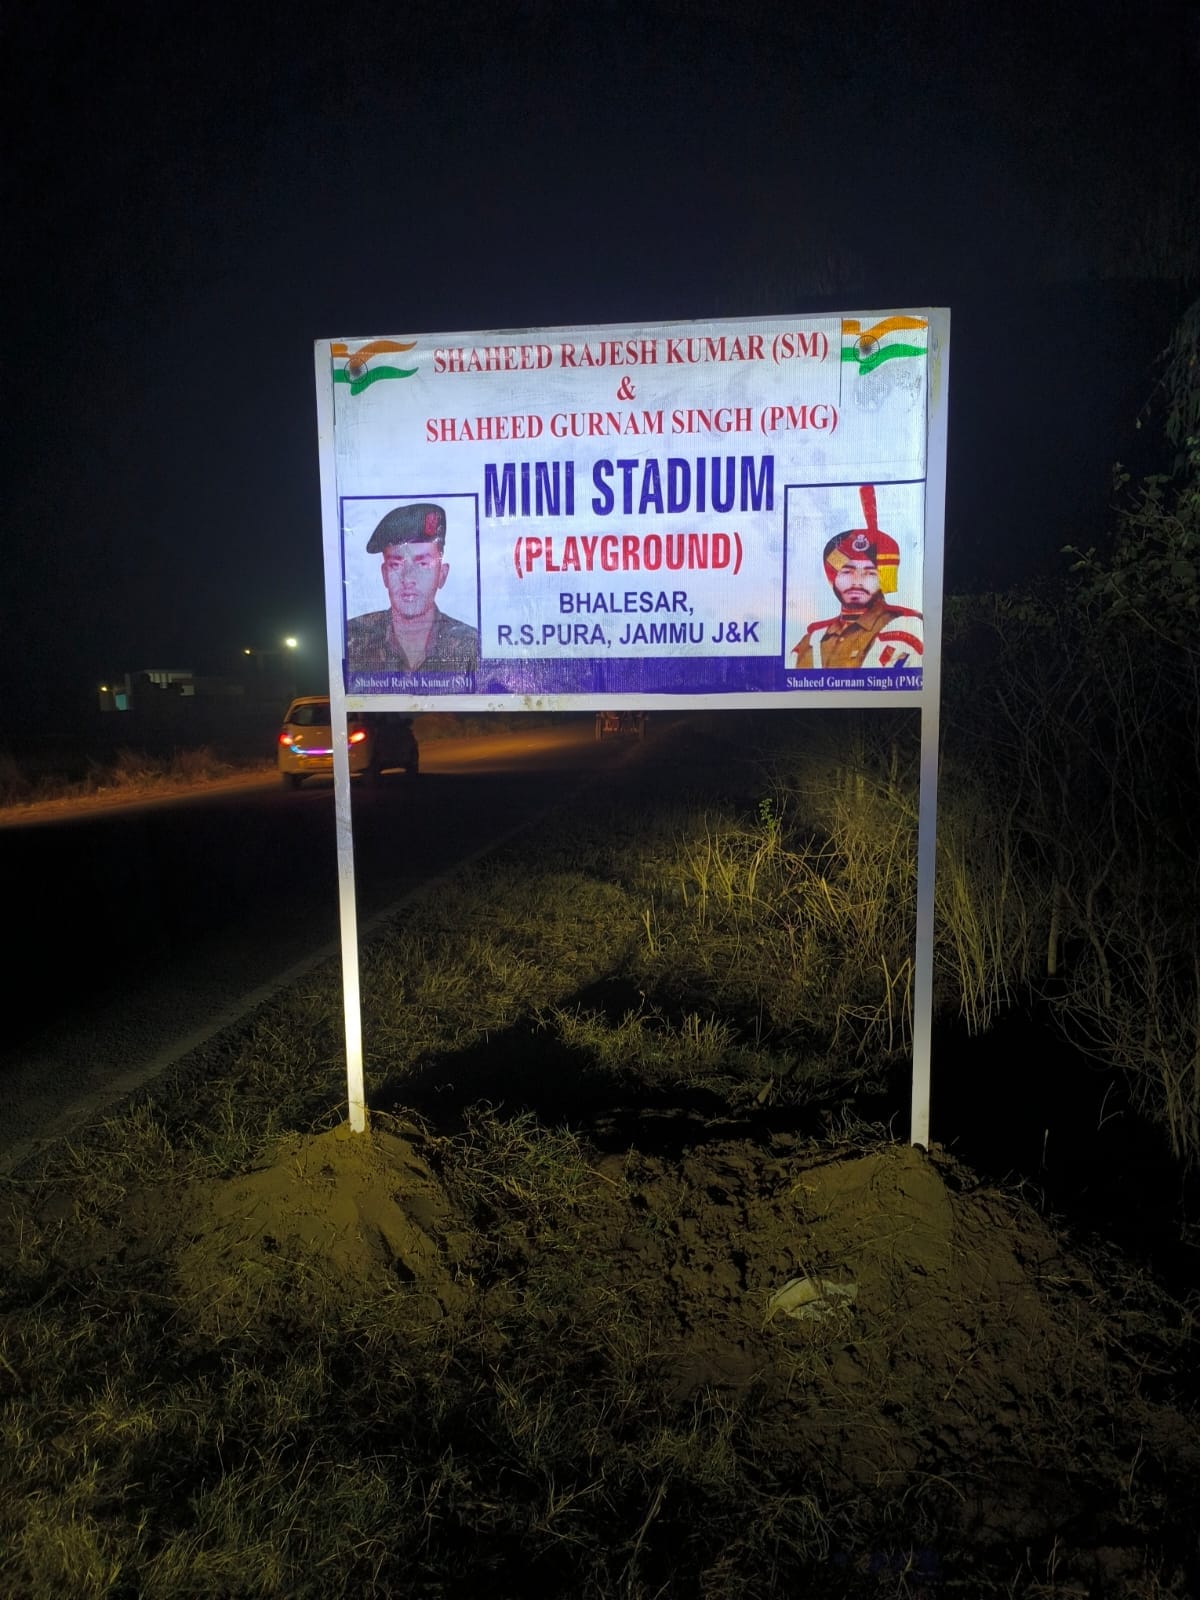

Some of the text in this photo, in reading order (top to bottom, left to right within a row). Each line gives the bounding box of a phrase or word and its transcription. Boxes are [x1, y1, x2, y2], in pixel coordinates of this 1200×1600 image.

[434, 331, 828, 374] SHAHEED RAJESH KUMAR (SM)
[616, 376, 636, 400] &
[426, 404, 838, 443] SHAHEED GURNAM SINGH (PMG)
[484, 455, 774, 517] MINI STADIUM
[514, 532, 743, 579] (PLAYGROUND)
[560, 591, 694, 616] BHALESAR,
[498, 622, 759, 648] R.S.PURA, JAMMU J&K
[355, 675, 473, 690] Shaheed Rajesh Kumar (SM)
[786, 677, 824, 688] Shaheed
[826, 676, 865, 687] Gurnam
[867, 675, 893, 689] Singh
